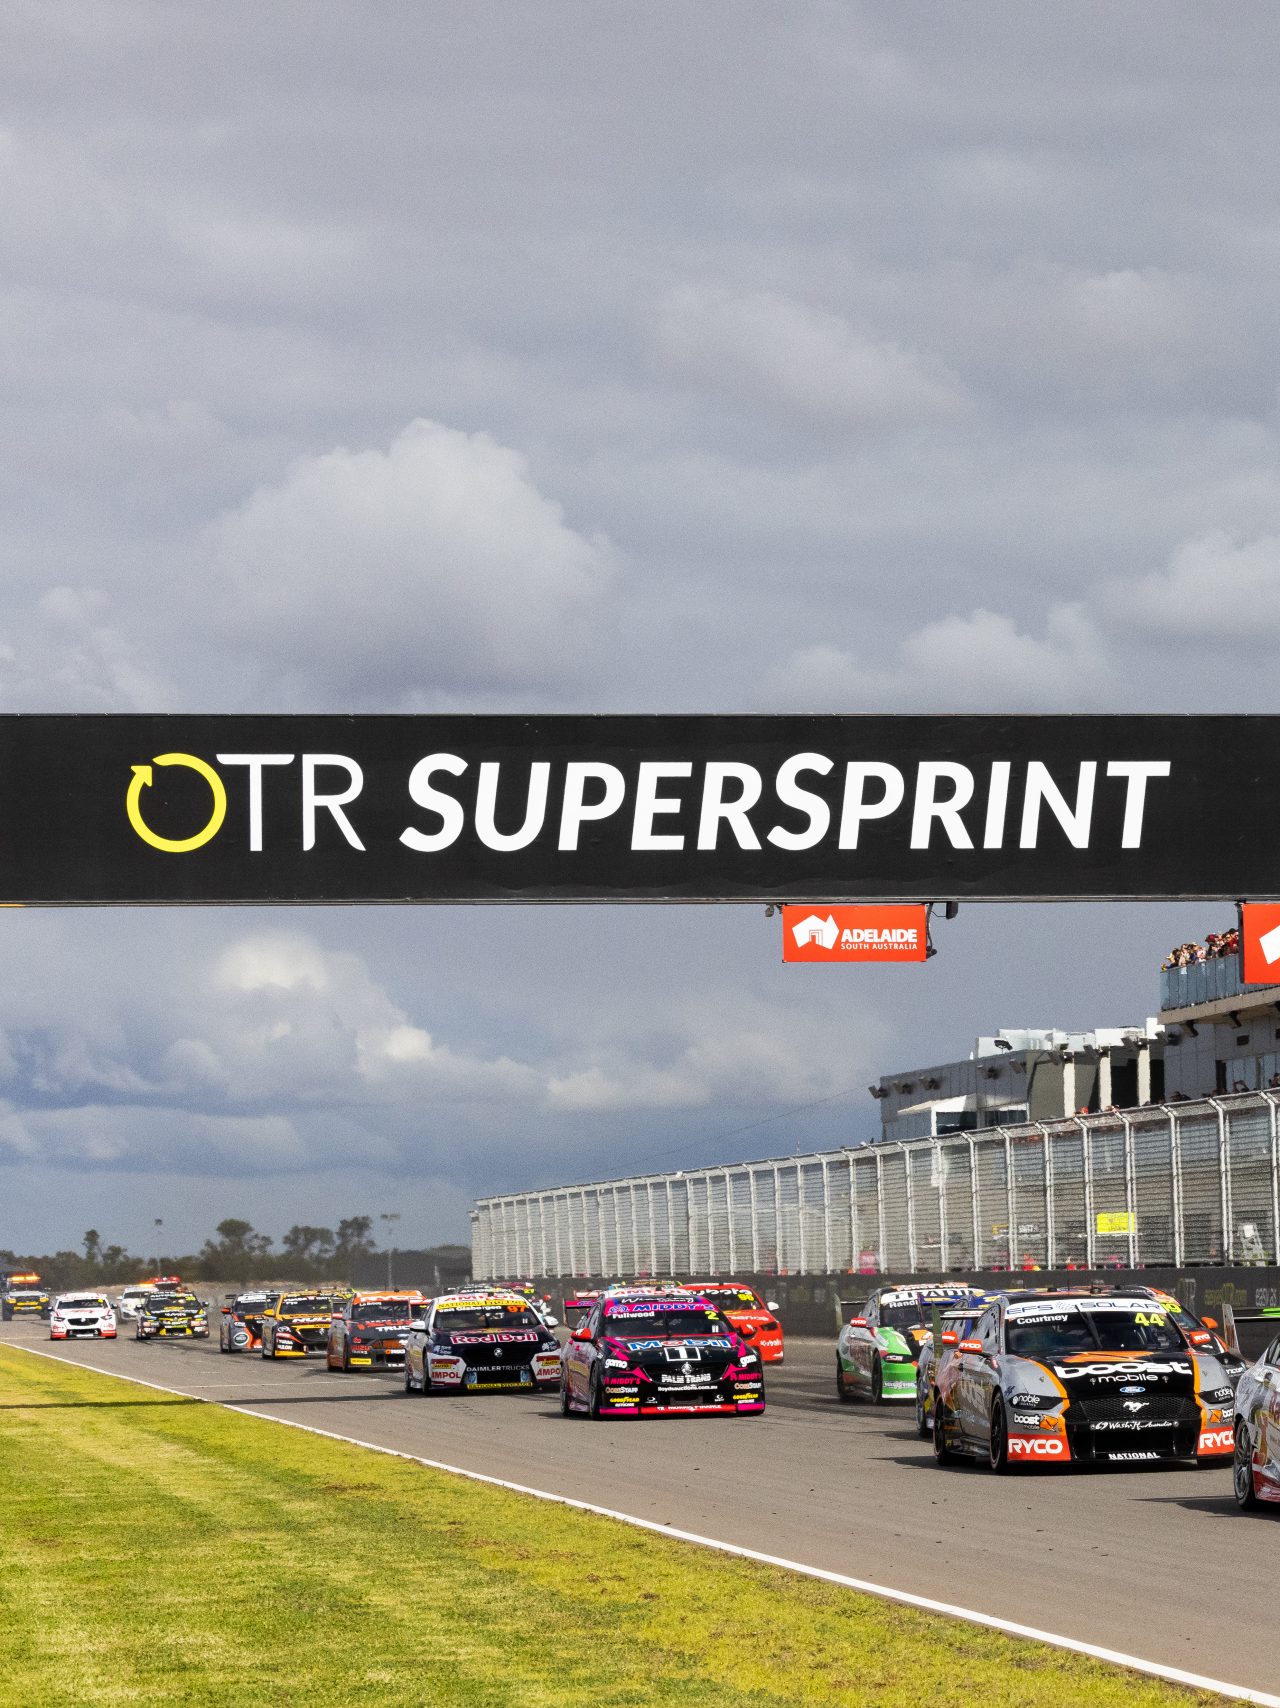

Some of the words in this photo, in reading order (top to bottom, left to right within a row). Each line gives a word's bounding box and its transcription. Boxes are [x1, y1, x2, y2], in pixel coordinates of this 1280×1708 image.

[126, 752, 367, 853] OTR
[399, 752, 1171, 853] SUPERSPRINT
[841, 928, 918, 943] ADELAIDE
[1006, 1303, 1054, 1315] EFS
[1080, 1301, 1161, 1311] SOLAR
[704, 1310, 719, 1320] 2
[1016, 1314, 1069, 1325] Courtney
[1134, 1313, 1164, 1327] 44
[451, 1334, 496, 1345] Red
[498, 1333, 539, 1343] Bull
[628, 1338, 732, 1351] Mobil
[537, 1368, 560, 1376] AMPO
[1053, 1360, 1193, 1379] boost
[1098, 1373, 1159, 1383] mobile
[1018, 1394, 1040, 1403] noble
[1014, 1412, 1040, 1425] boost
[1222, 1408, 1234, 1418] boo
[1008, 1438, 1063, 1454] RYCO
[1108, 1451, 1161, 1460] NATIONAL
